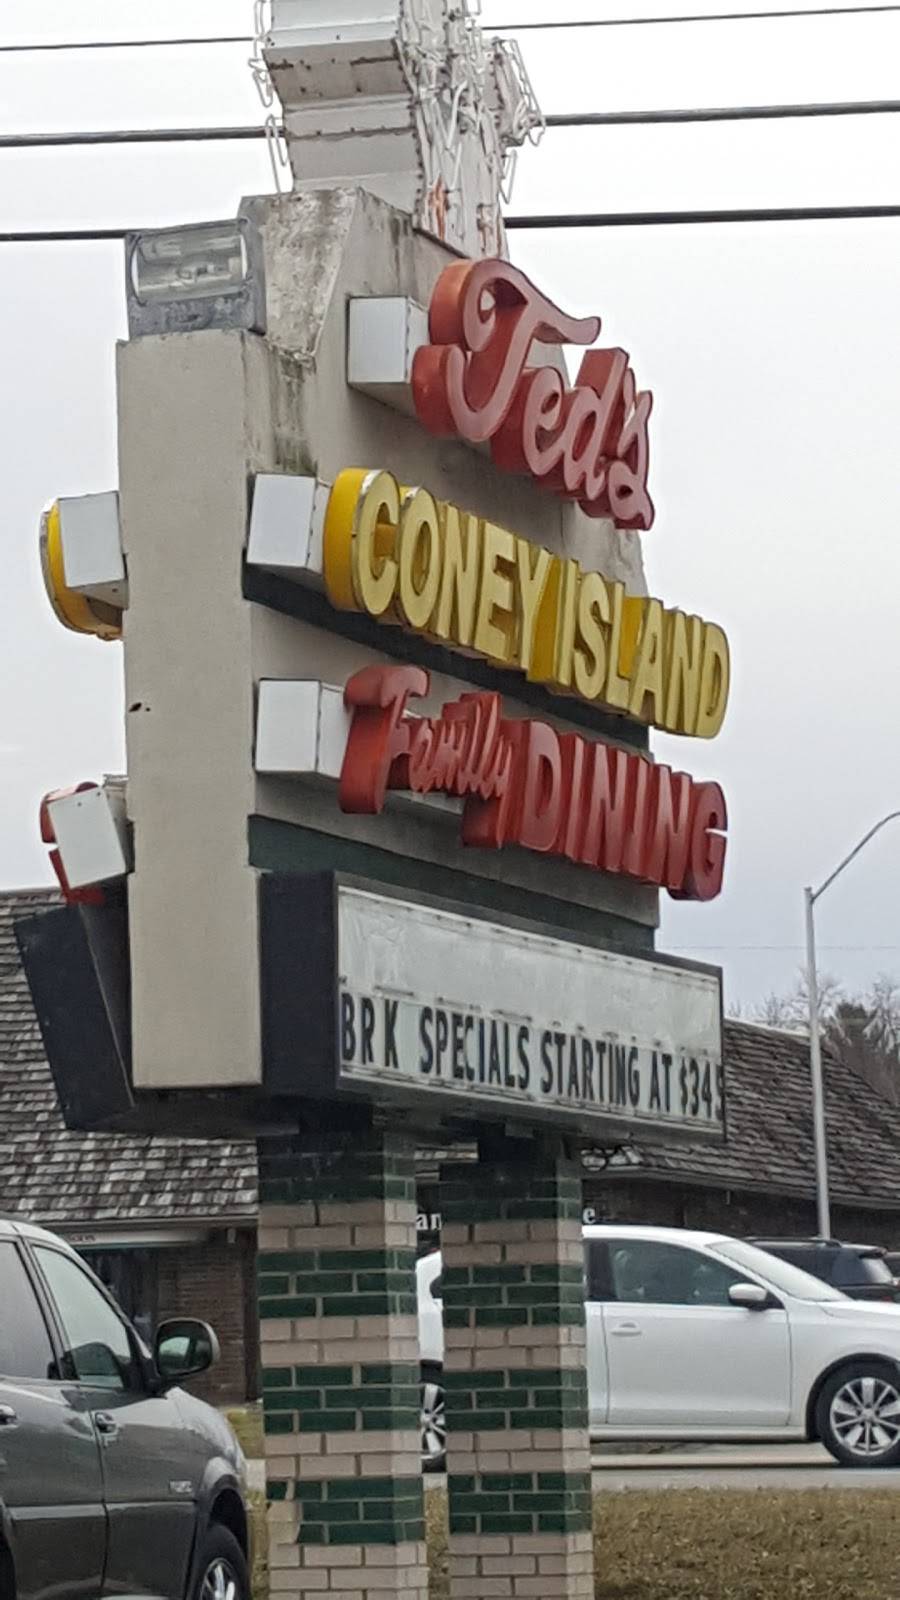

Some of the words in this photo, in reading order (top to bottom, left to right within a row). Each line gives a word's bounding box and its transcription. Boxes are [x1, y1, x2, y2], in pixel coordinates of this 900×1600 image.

[413, 258, 655, 530] Ted's
[324, 468, 553, 673] CONEY
[556, 557, 730, 739] ISLAND
[342, 665, 514, 850] Family
[517, 719, 728, 902] DINING
[419, 1006, 530, 1090] SPECIALS
[540, 1030, 640, 1107] STARTING
[648, 1050, 672, 1113] AT
